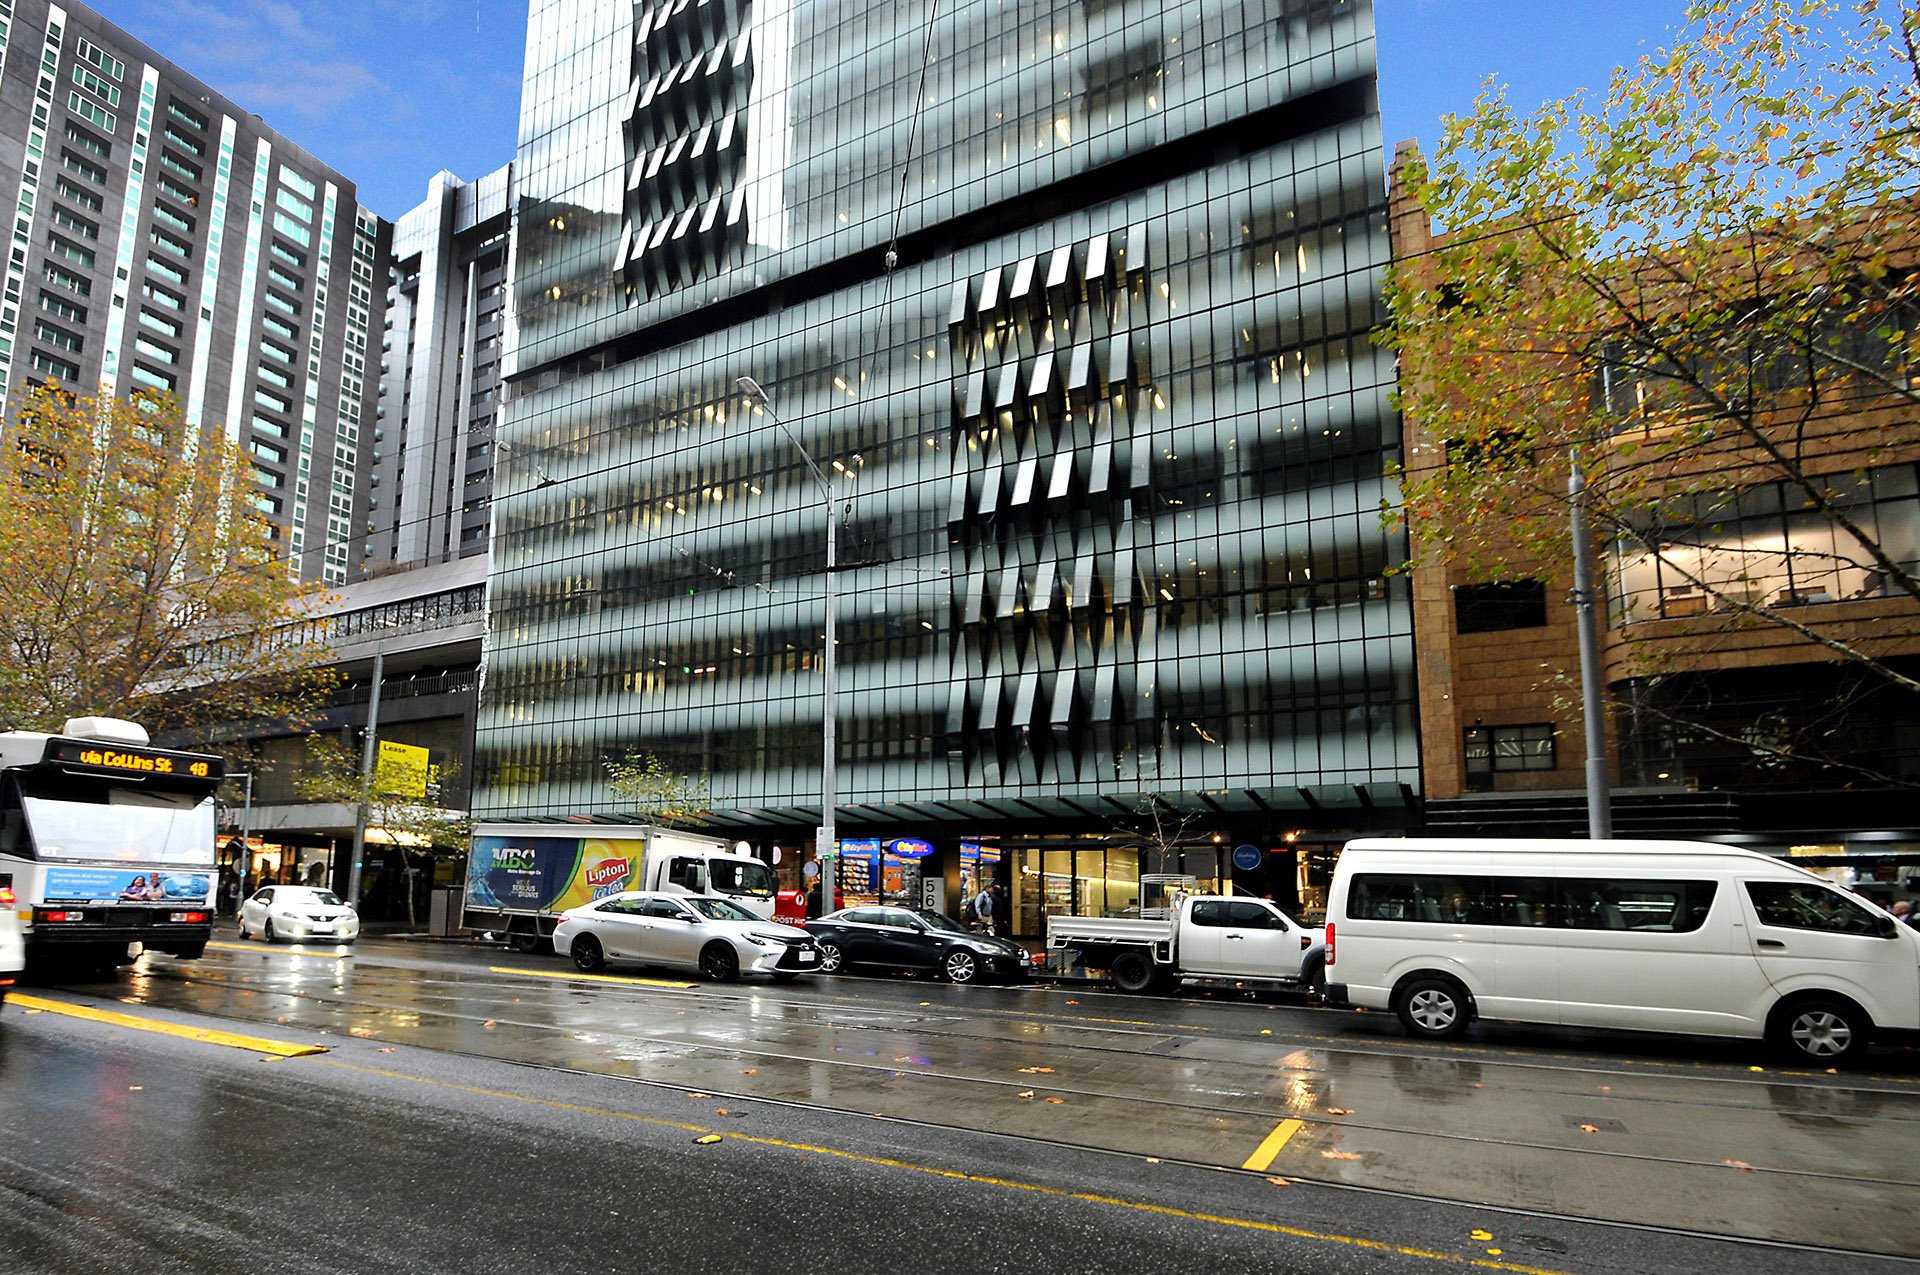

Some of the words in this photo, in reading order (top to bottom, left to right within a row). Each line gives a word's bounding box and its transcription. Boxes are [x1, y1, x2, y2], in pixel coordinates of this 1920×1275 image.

[383, 744, 407, 753] Lease
[80, 750, 103, 764] via
[103, 751, 154, 771] Collins
[154, 757, 174, 772] St
[189, 762, 209, 776] 48
[491, 847, 536, 869] MBC
[588, 863, 625, 882] Lipton
